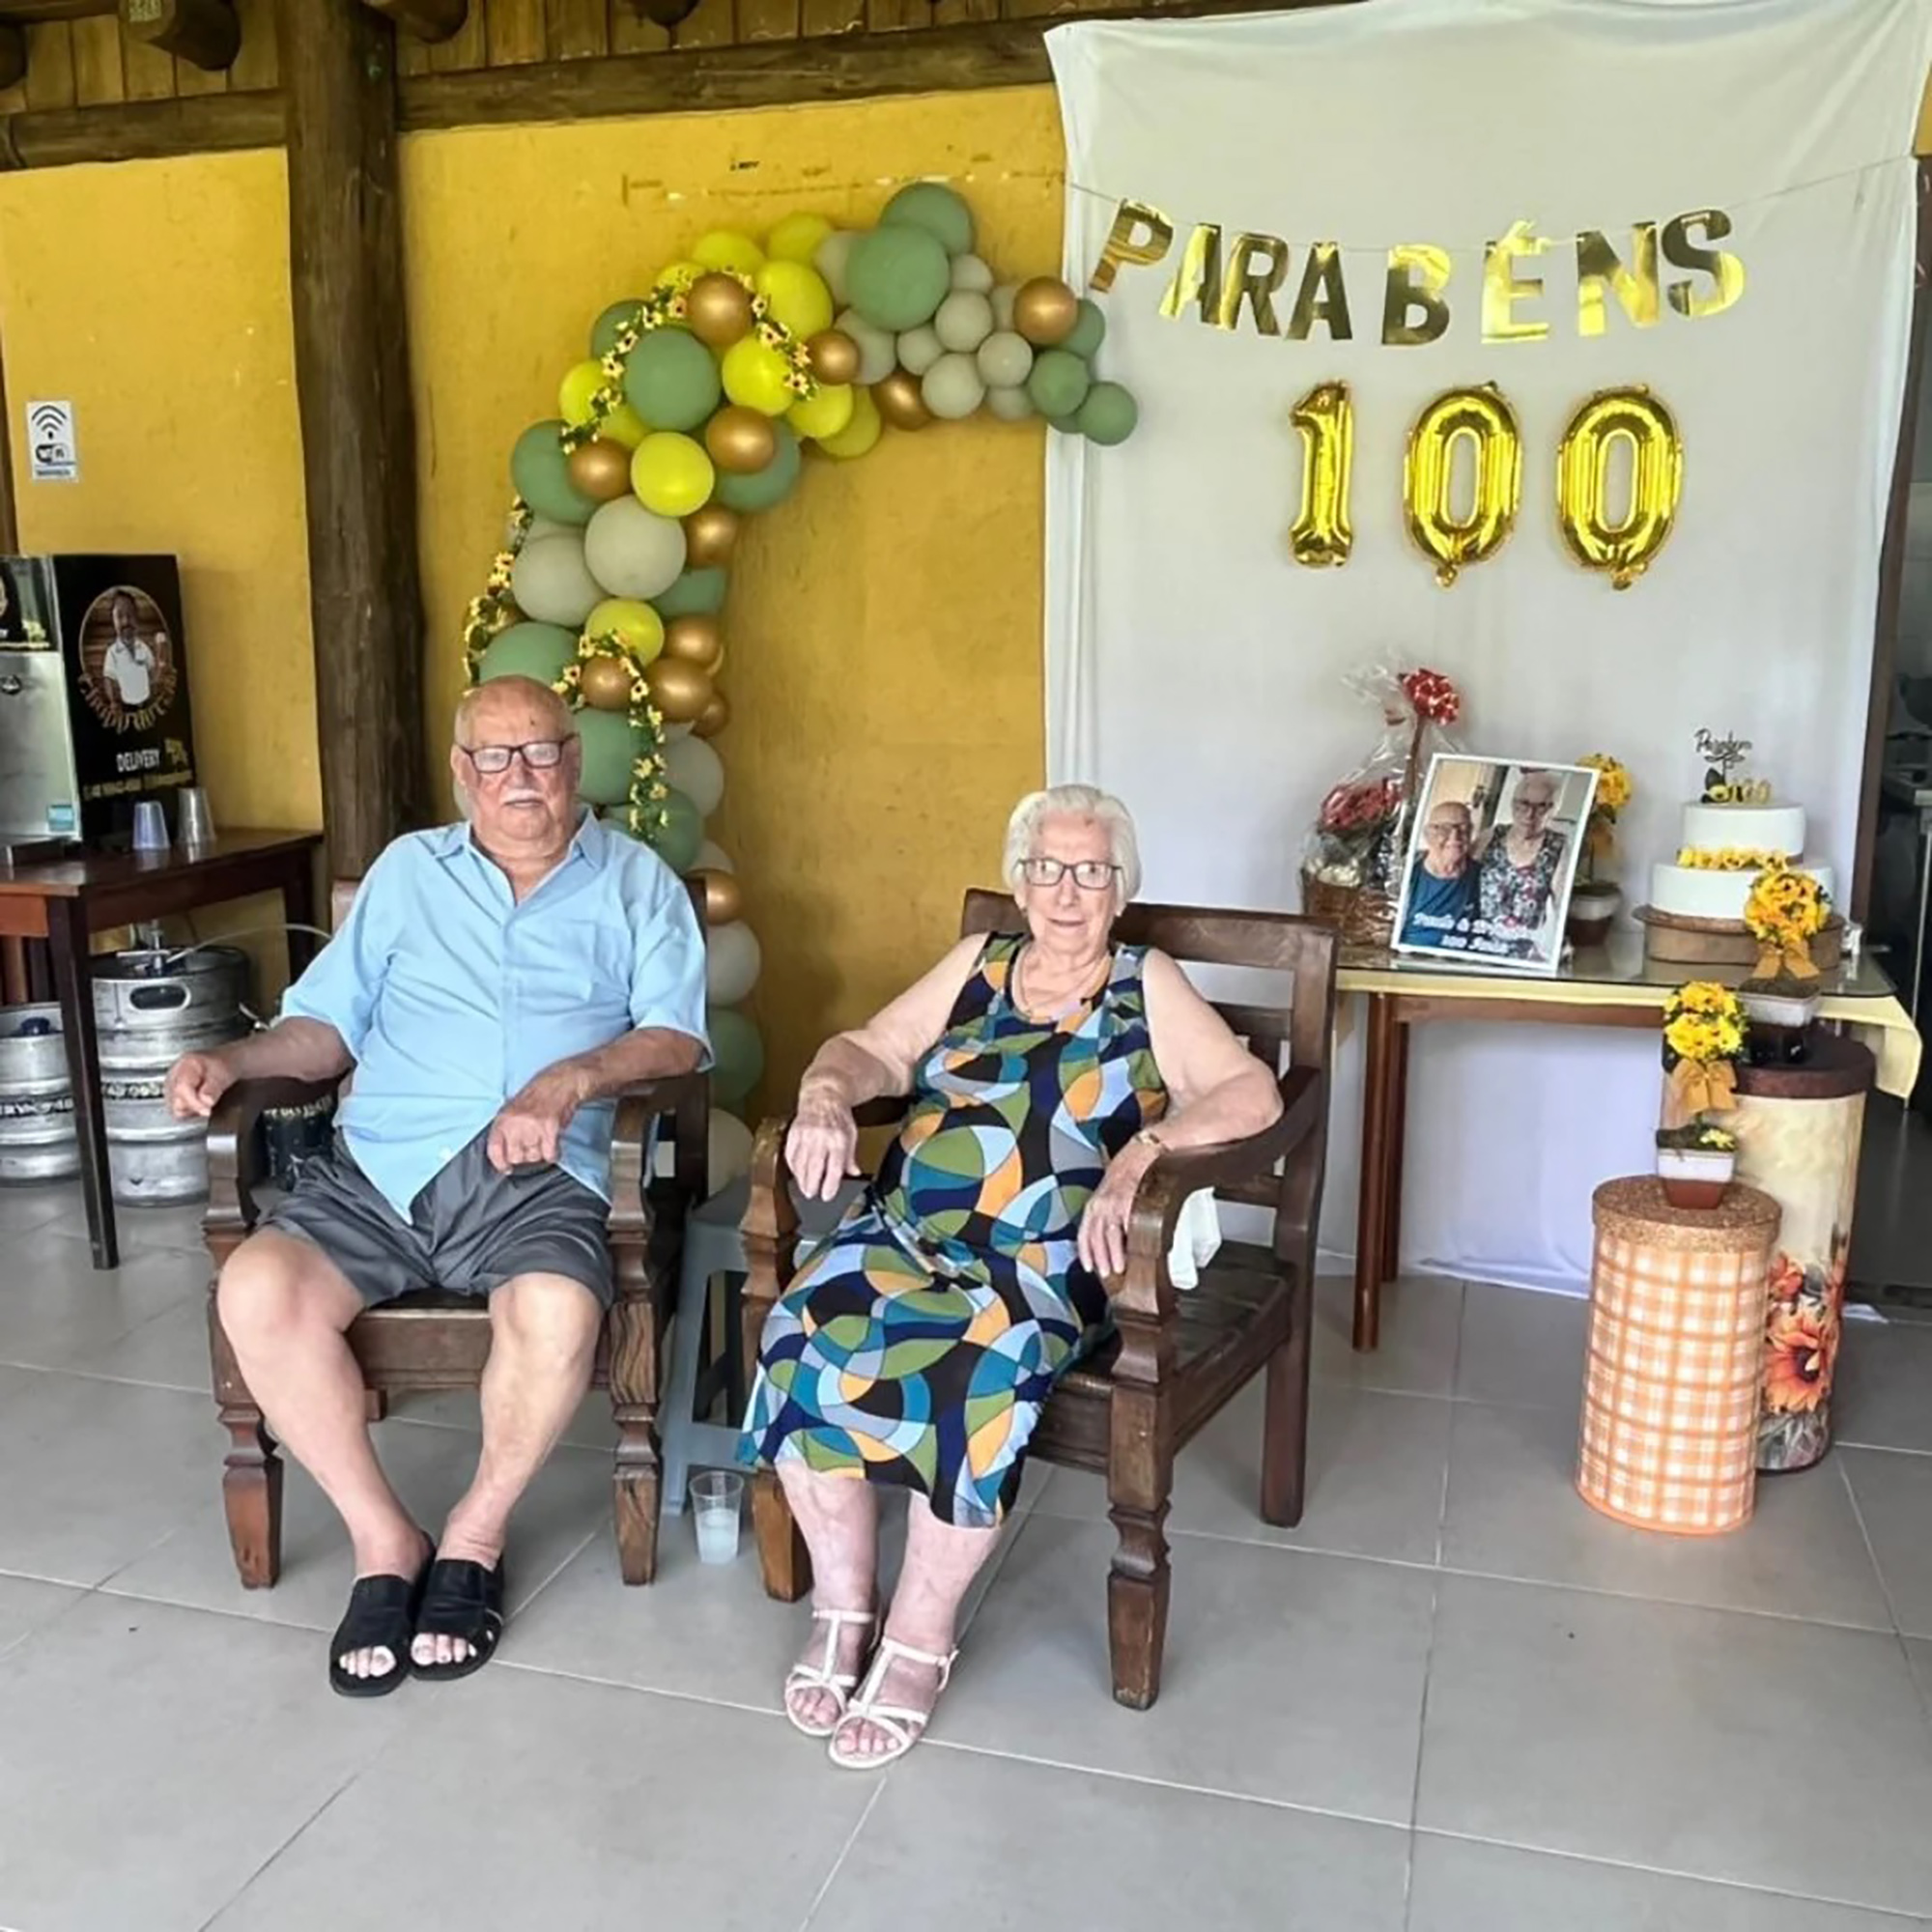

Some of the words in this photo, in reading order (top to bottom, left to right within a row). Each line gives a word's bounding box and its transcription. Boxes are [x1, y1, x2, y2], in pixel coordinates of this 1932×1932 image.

[1089, 198, 1746, 346] PARABÉNS
[1288, 379, 1684, 591] 100
[117, 749, 159, 772] DELIVERY
